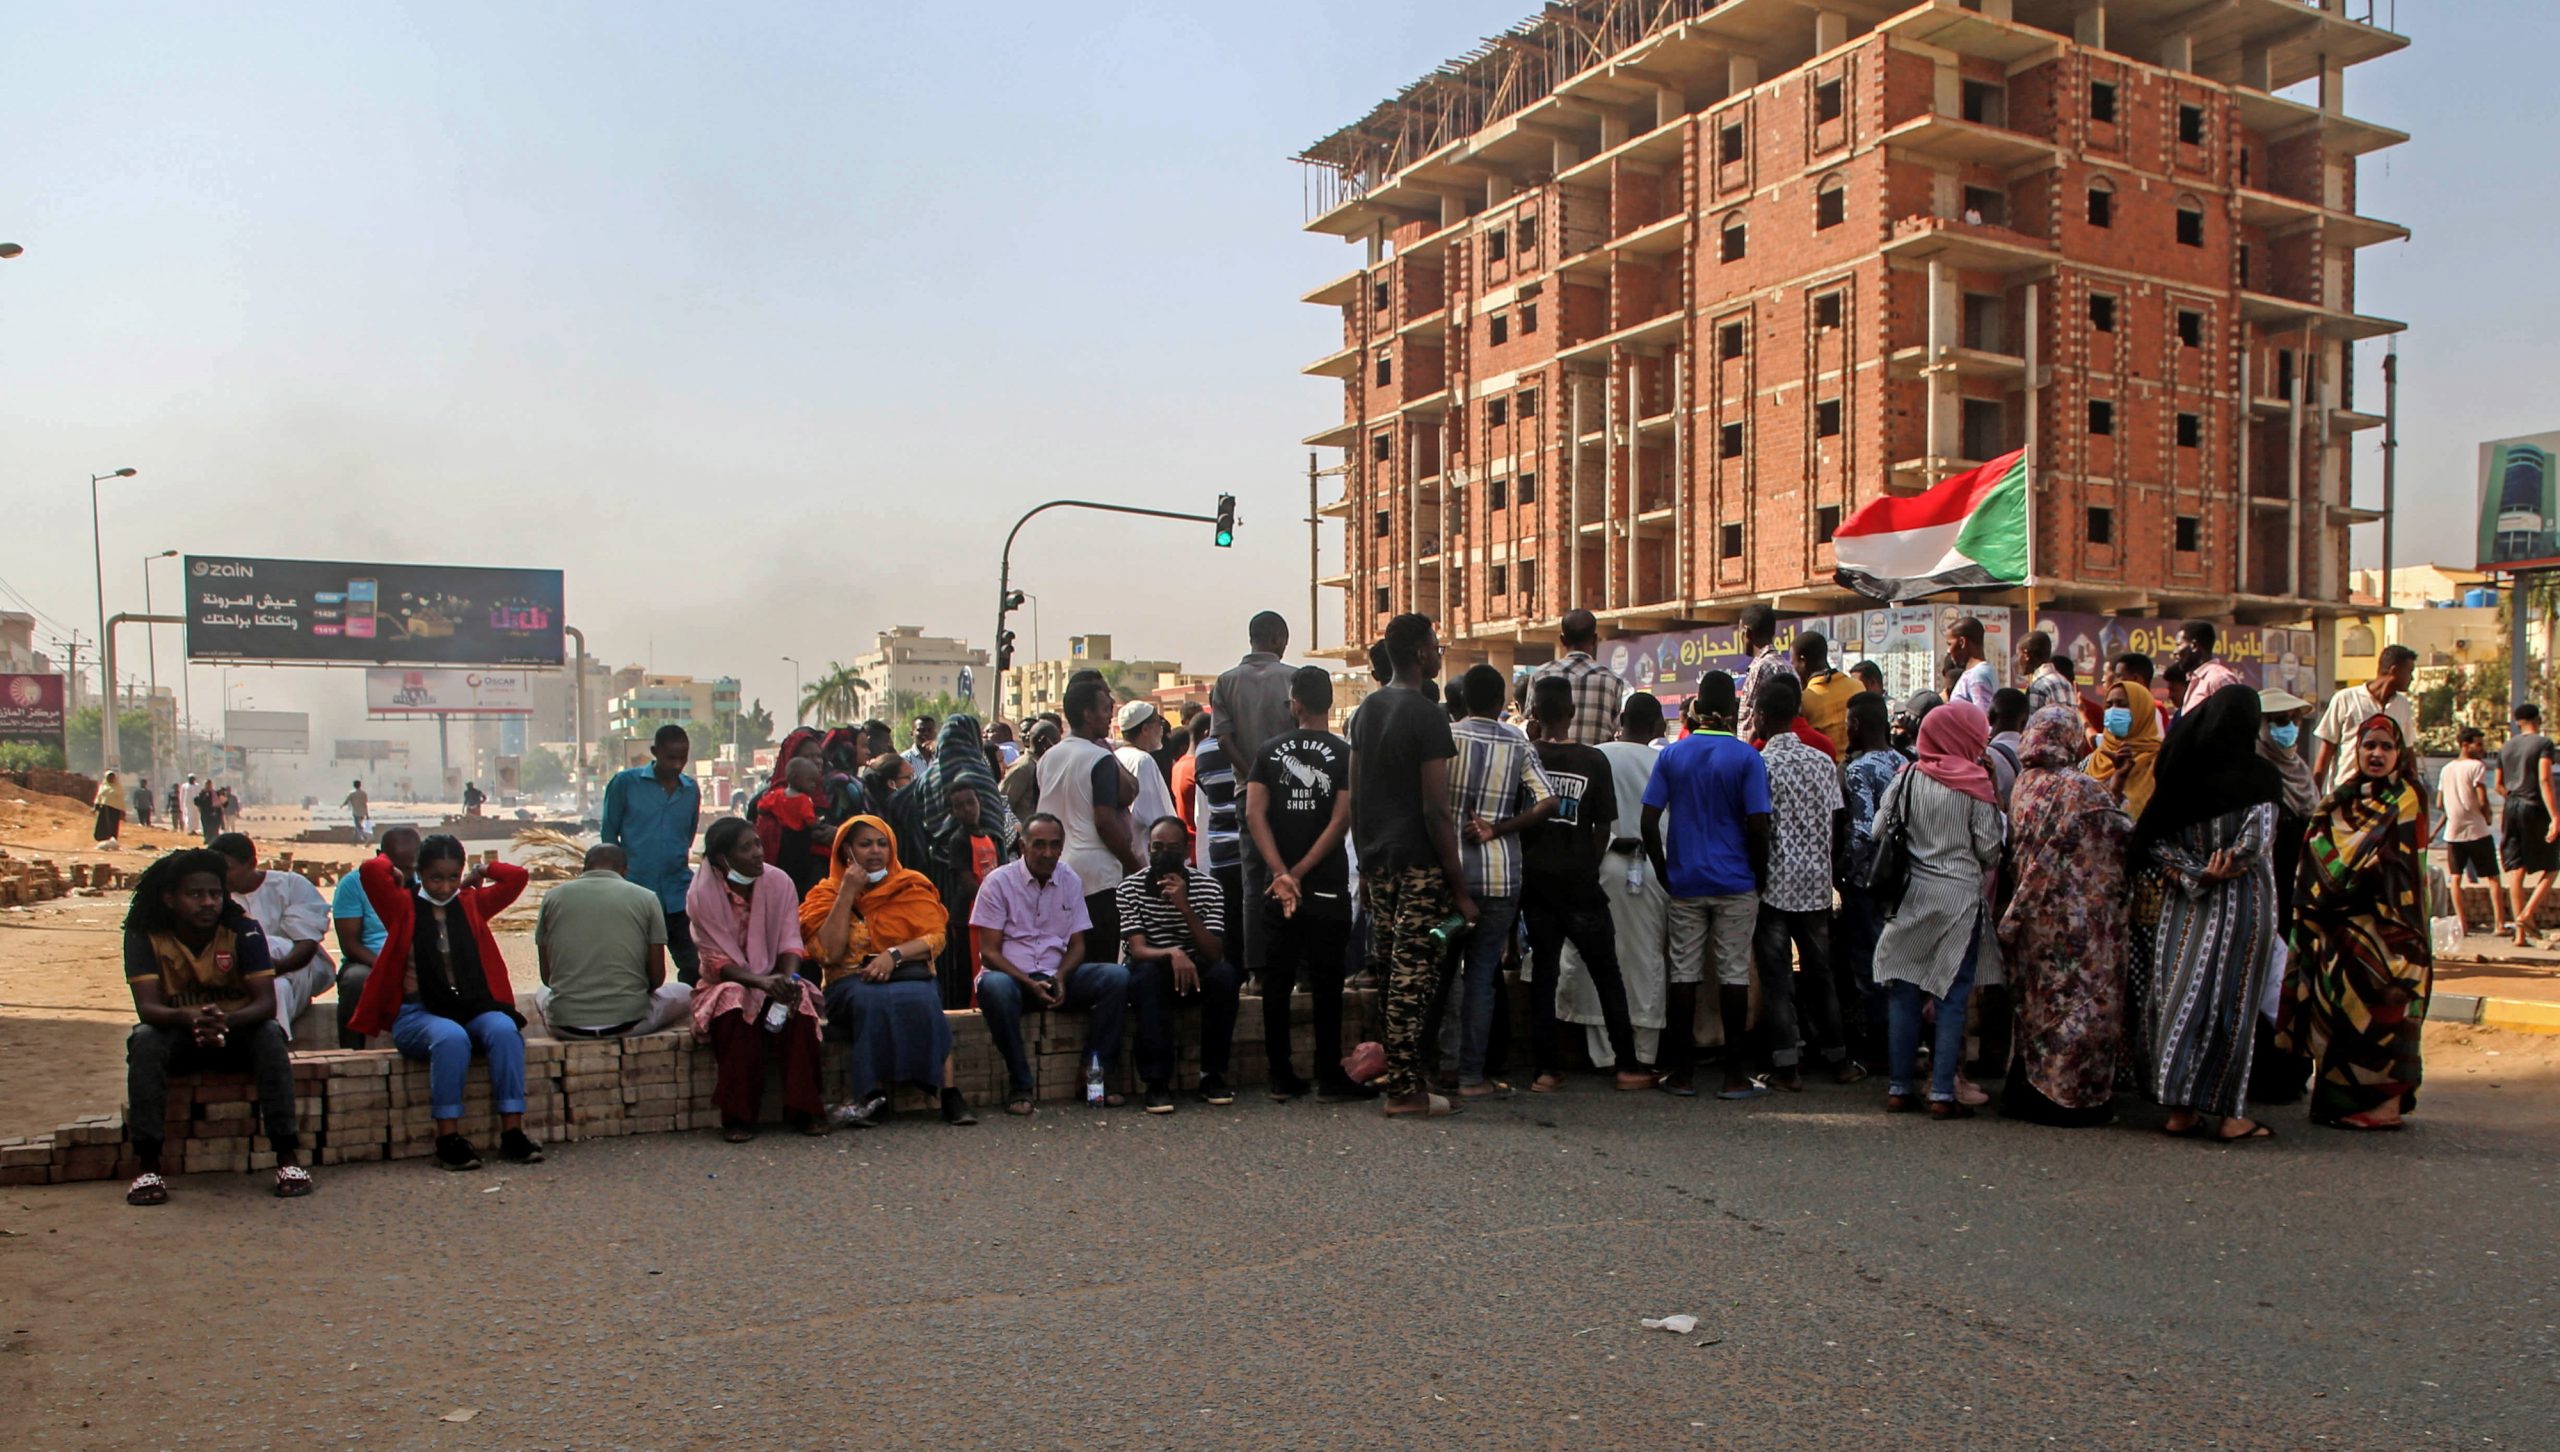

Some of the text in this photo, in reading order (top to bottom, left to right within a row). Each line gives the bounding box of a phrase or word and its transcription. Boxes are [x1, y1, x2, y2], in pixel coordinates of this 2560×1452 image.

[2212, 630, 2262, 664] بانورام
[1270, 740, 1335, 762] LESS DRAMA
